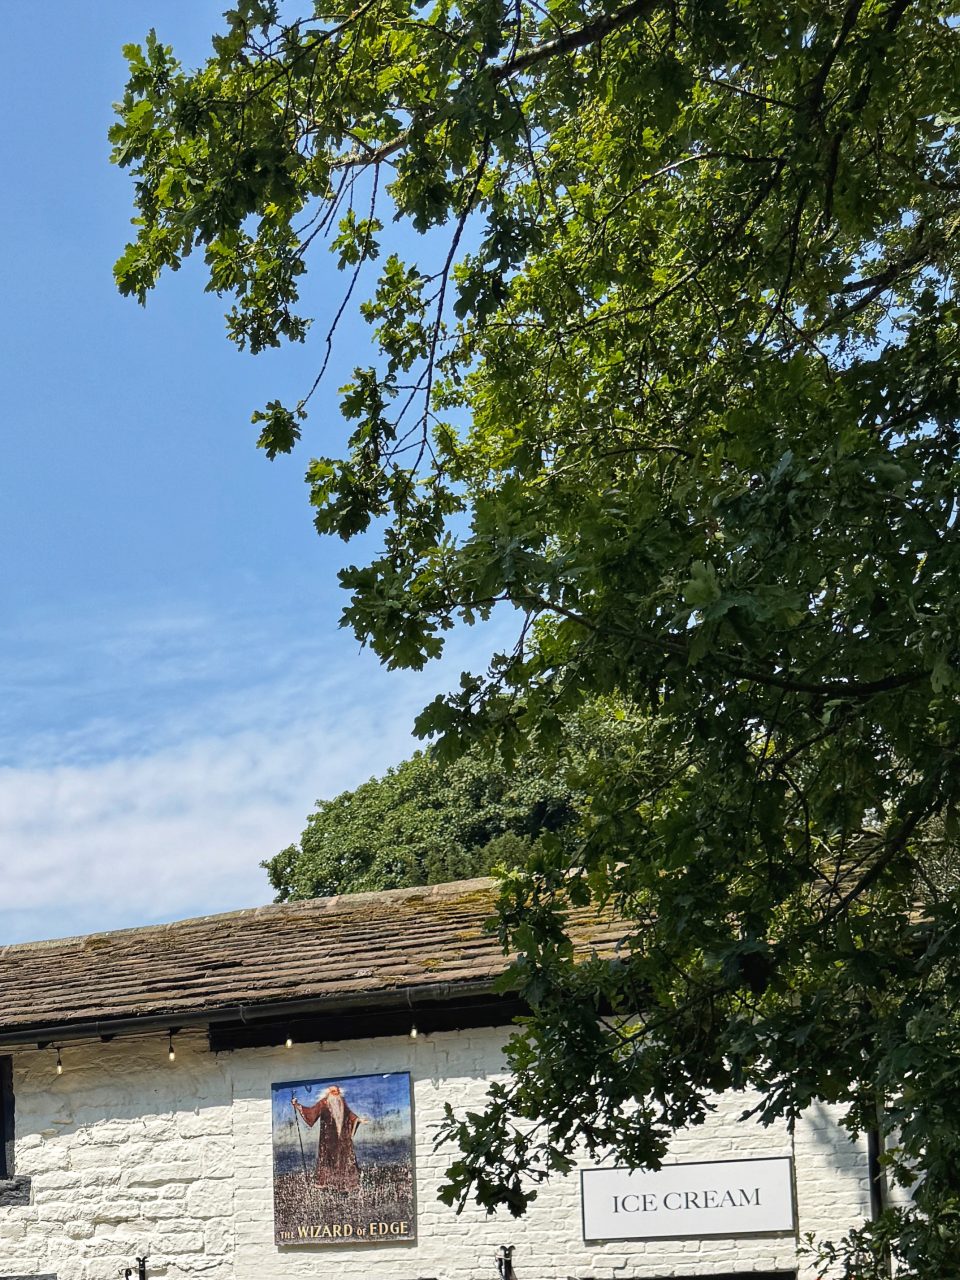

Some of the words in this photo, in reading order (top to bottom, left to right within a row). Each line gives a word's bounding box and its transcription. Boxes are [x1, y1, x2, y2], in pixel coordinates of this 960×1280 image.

[613, 1193, 658, 1213] ICE
[662, 1188, 761, 1210] CREAM
[297, 1224, 353, 1238] WIZARD
[370, 1221, 408, 1235] EDGE
